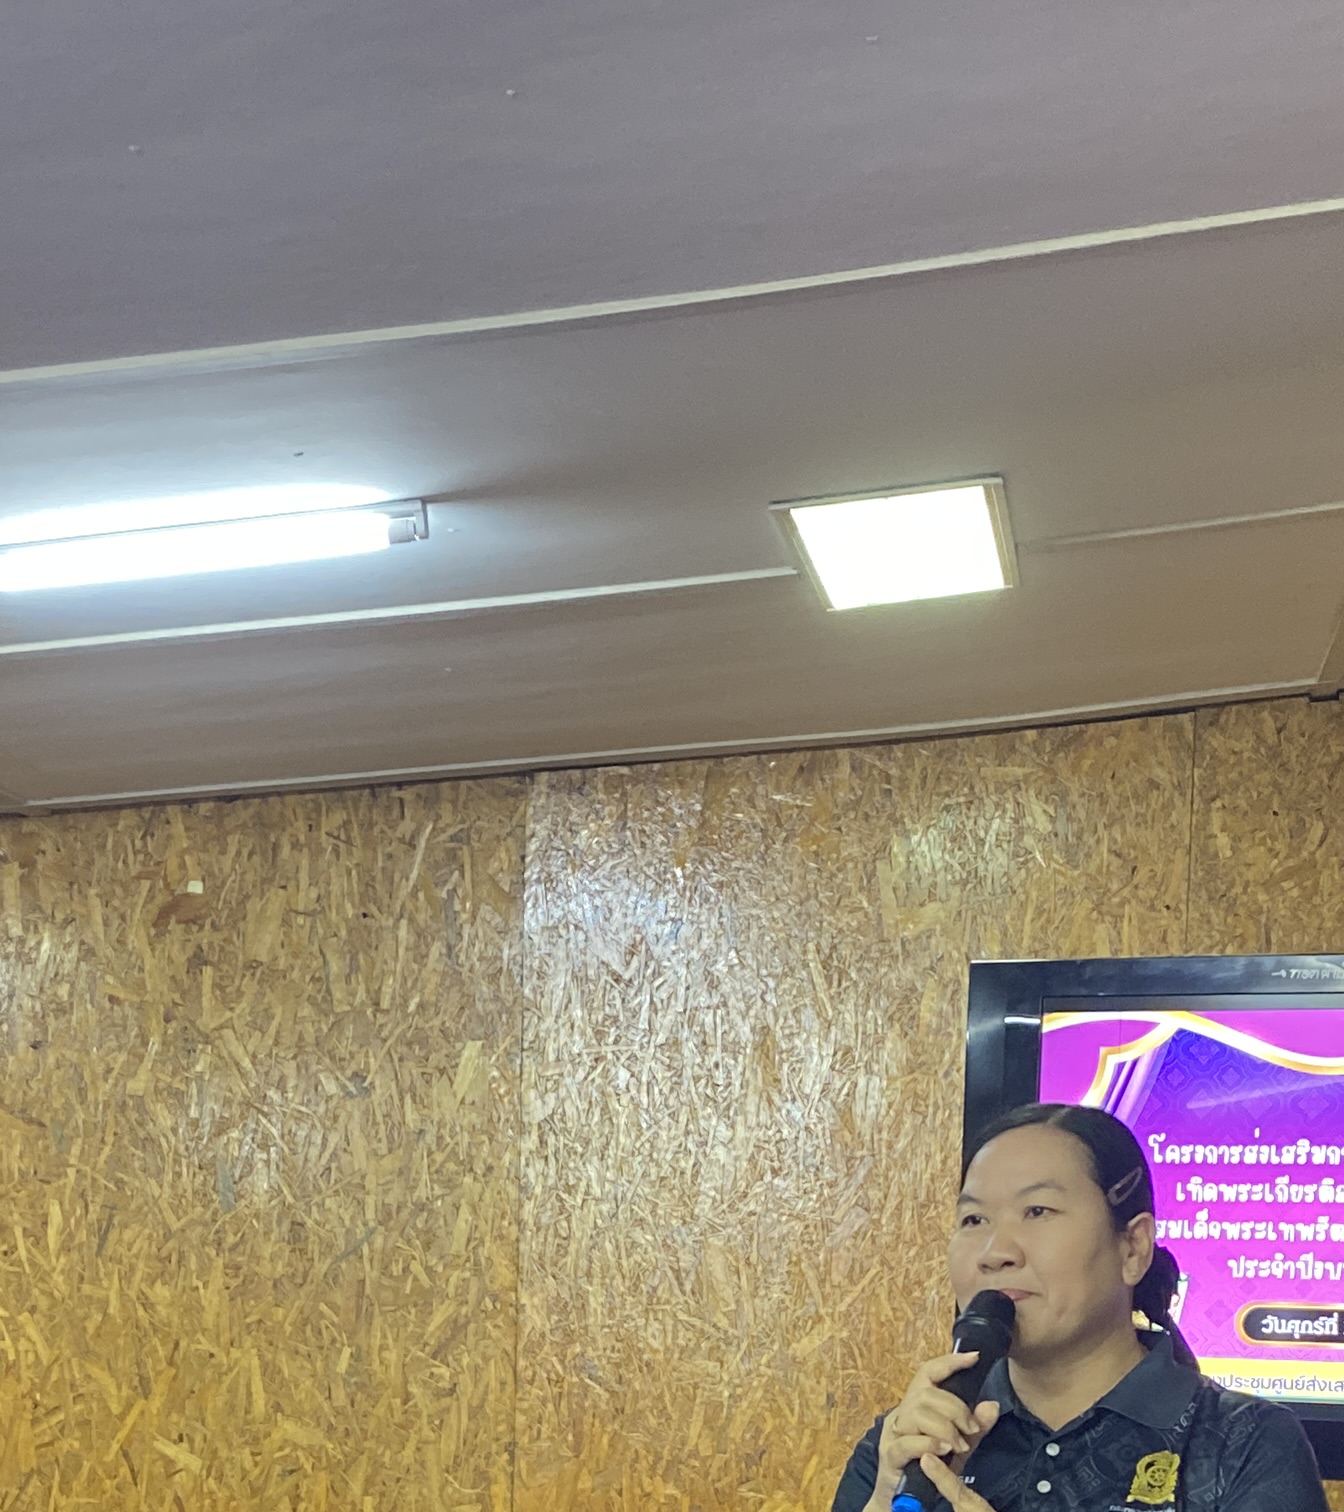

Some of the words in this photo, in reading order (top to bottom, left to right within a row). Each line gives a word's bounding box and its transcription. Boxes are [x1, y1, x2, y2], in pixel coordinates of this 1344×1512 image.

[1260, 1312, 1340, 1340] วันศุกร์ที่
